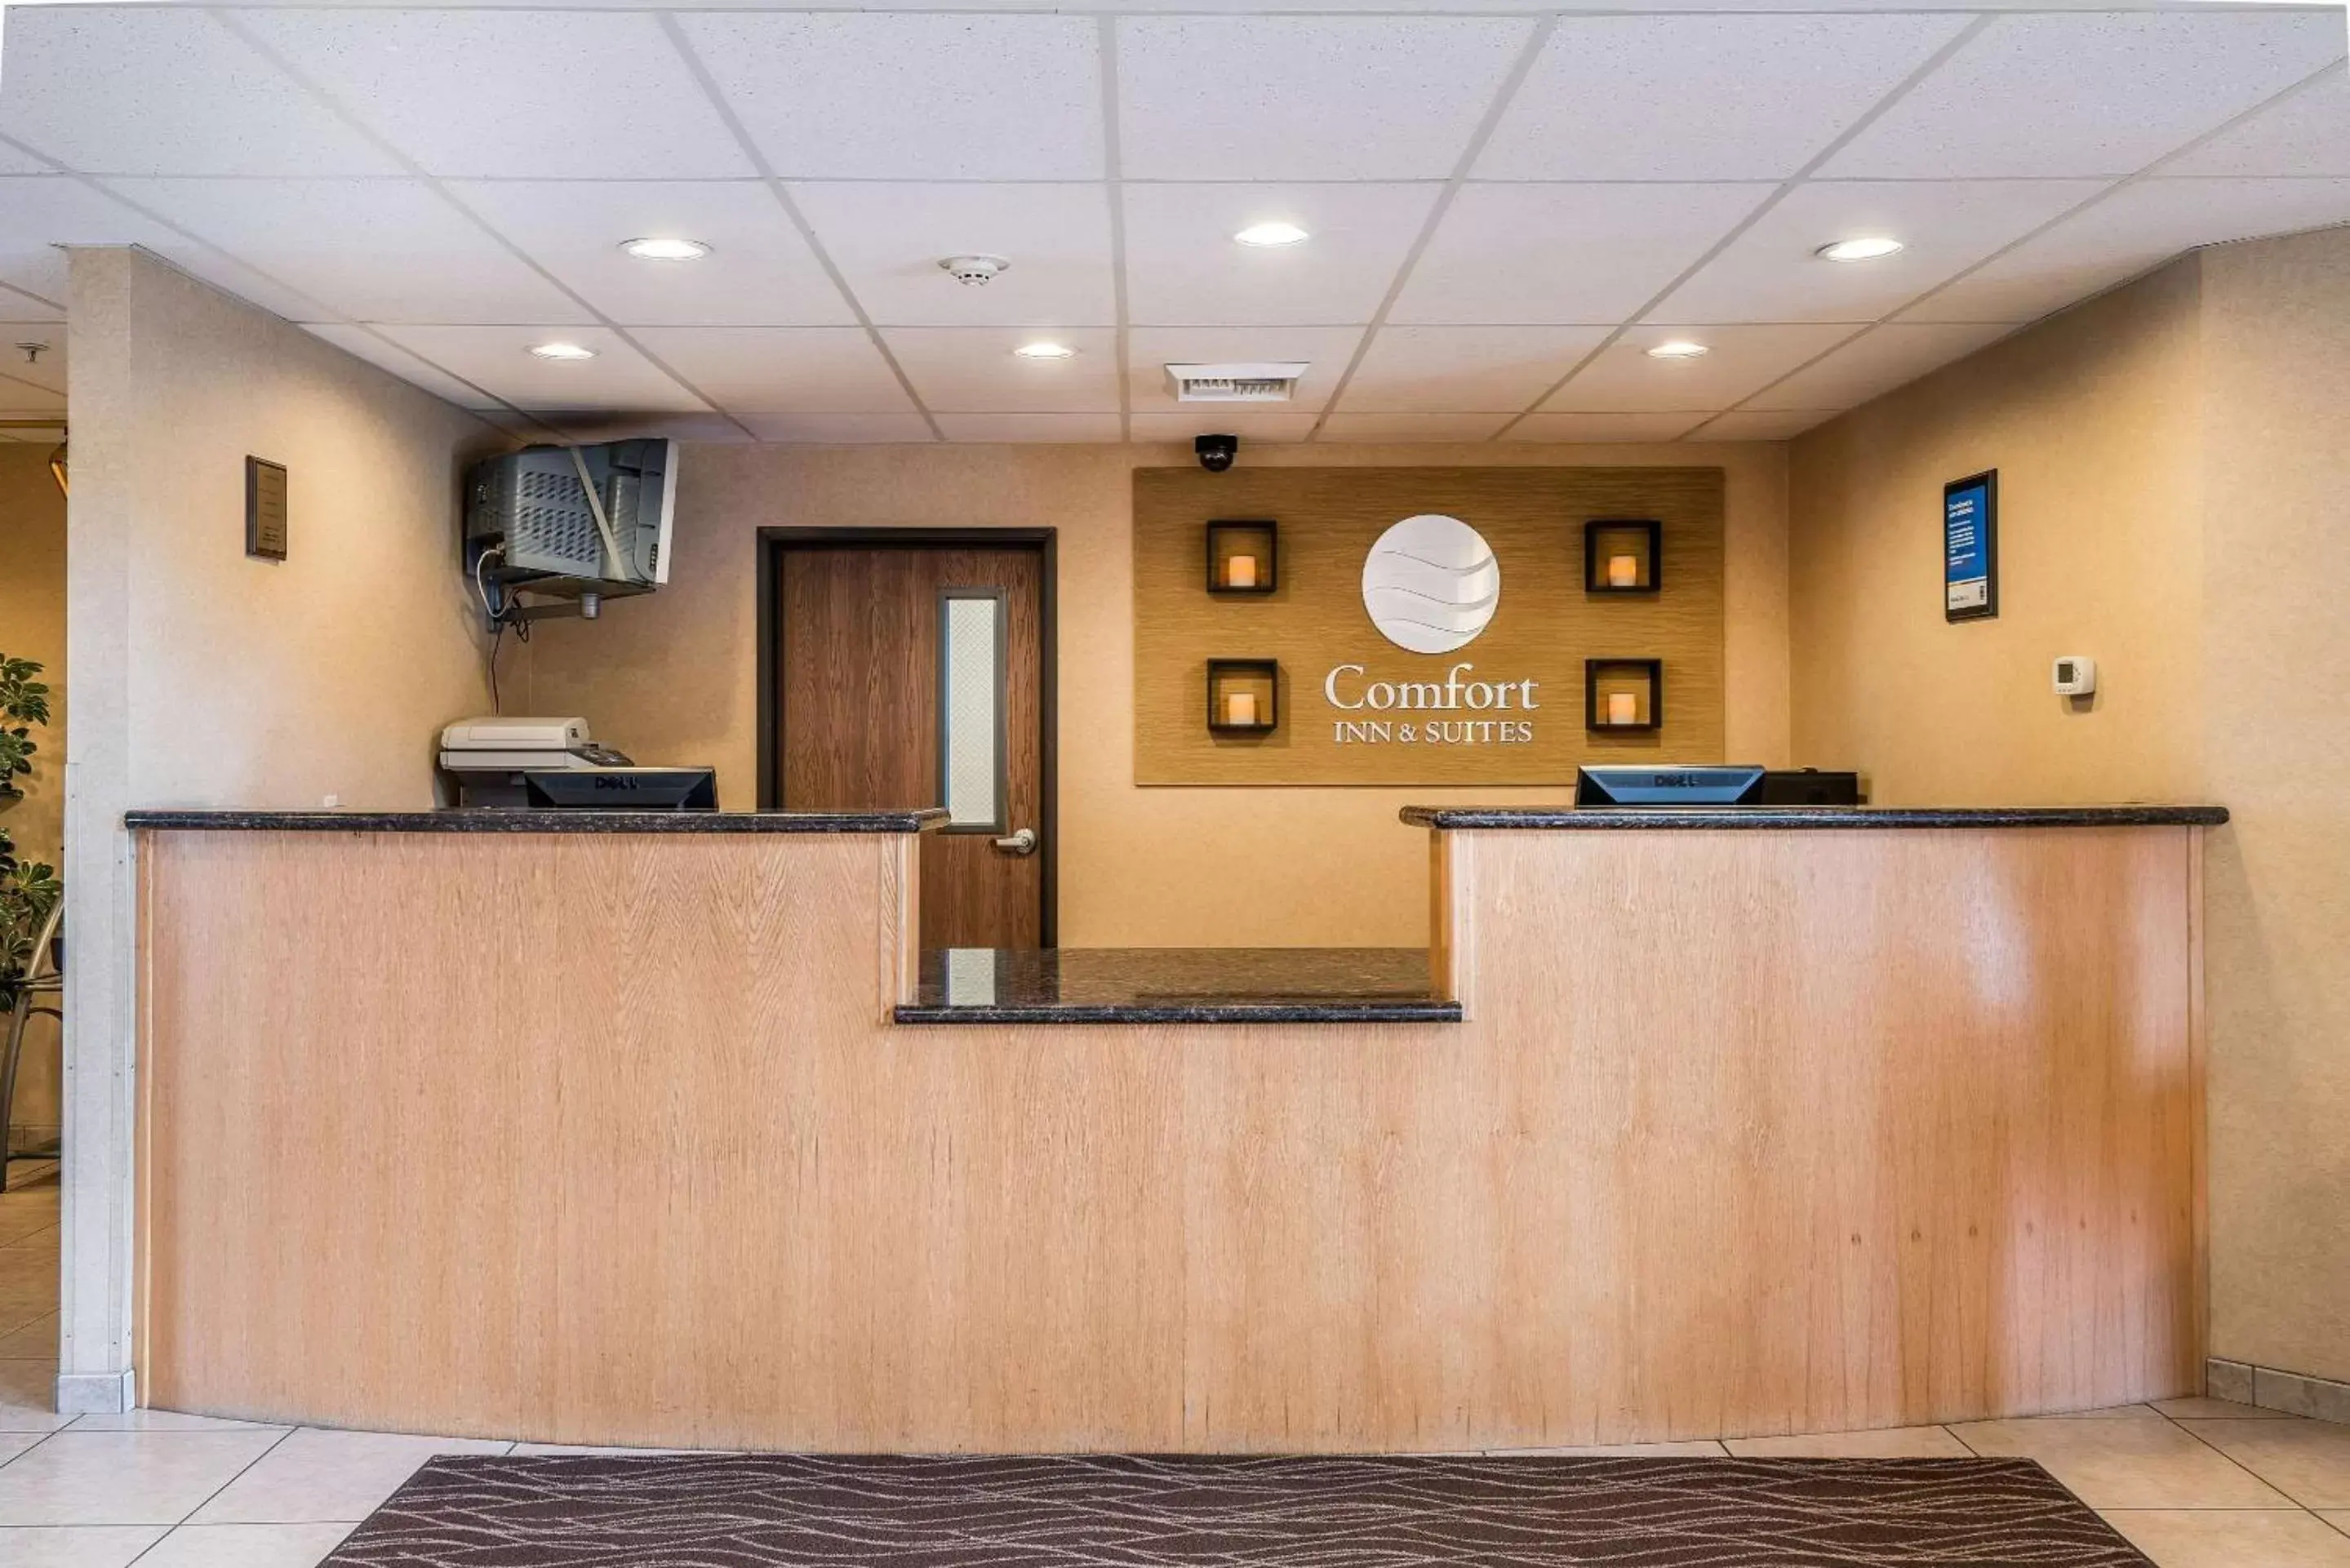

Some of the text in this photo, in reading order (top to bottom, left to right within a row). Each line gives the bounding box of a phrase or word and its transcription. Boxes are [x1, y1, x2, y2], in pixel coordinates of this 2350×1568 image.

[1324, 663, 1540, 709] Comfort
[1335, 721, 1533, 744] INN & SUITES
[595, 776, 638, 789] DELL
[1654, 775, 1697, 787] DELL
